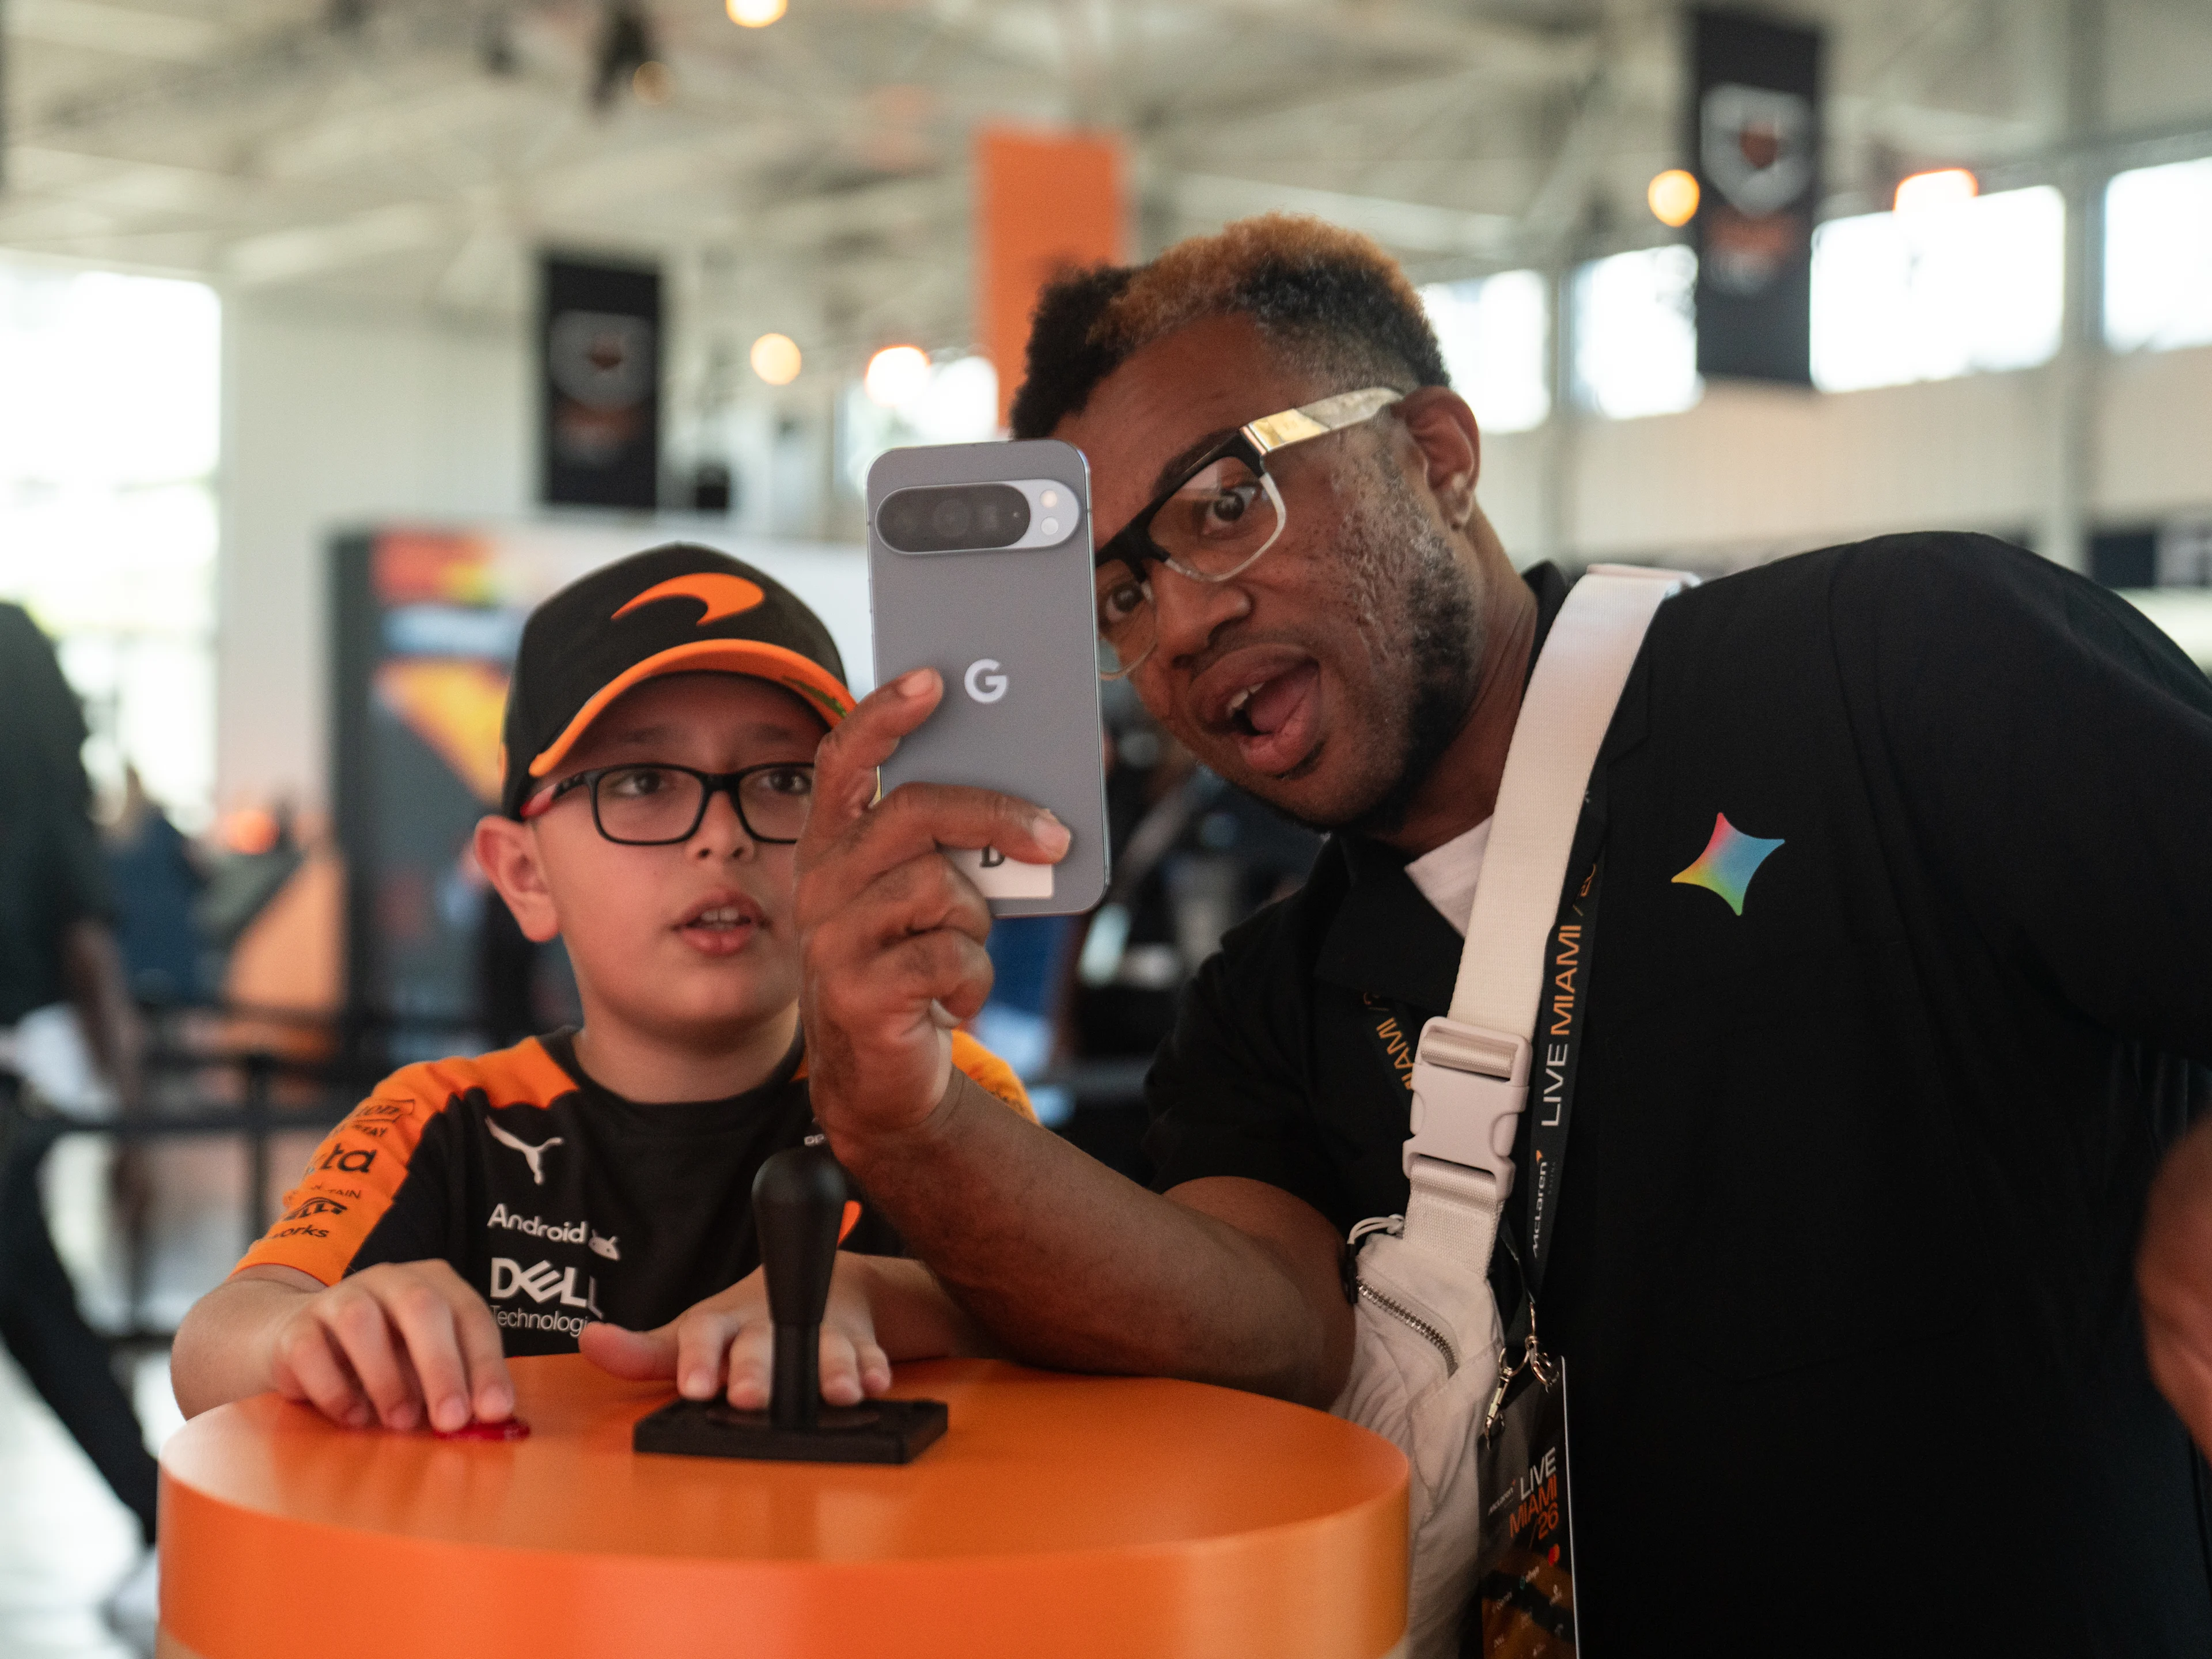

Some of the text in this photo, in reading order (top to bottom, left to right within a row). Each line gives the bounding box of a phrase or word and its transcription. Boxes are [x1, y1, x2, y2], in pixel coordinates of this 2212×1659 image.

[964, 658, 1009, 704] G
[1541, 925, 1581, 1126] LIVE MIAMI
[1376, 1017, 1414, 1090] IAMI
[319, 1143, 377, 1173] ta
[273, 1225, 329, 1238] orks
[487, 1203, 588, 1244] Android
[490, 1257, 604, 1320] DELL
[490, 1304, 588, 1338] Technologi
[1520, 1446, 1556, 1501] LIVE
[1510, 1474, 1558, 1539] MIAMI
